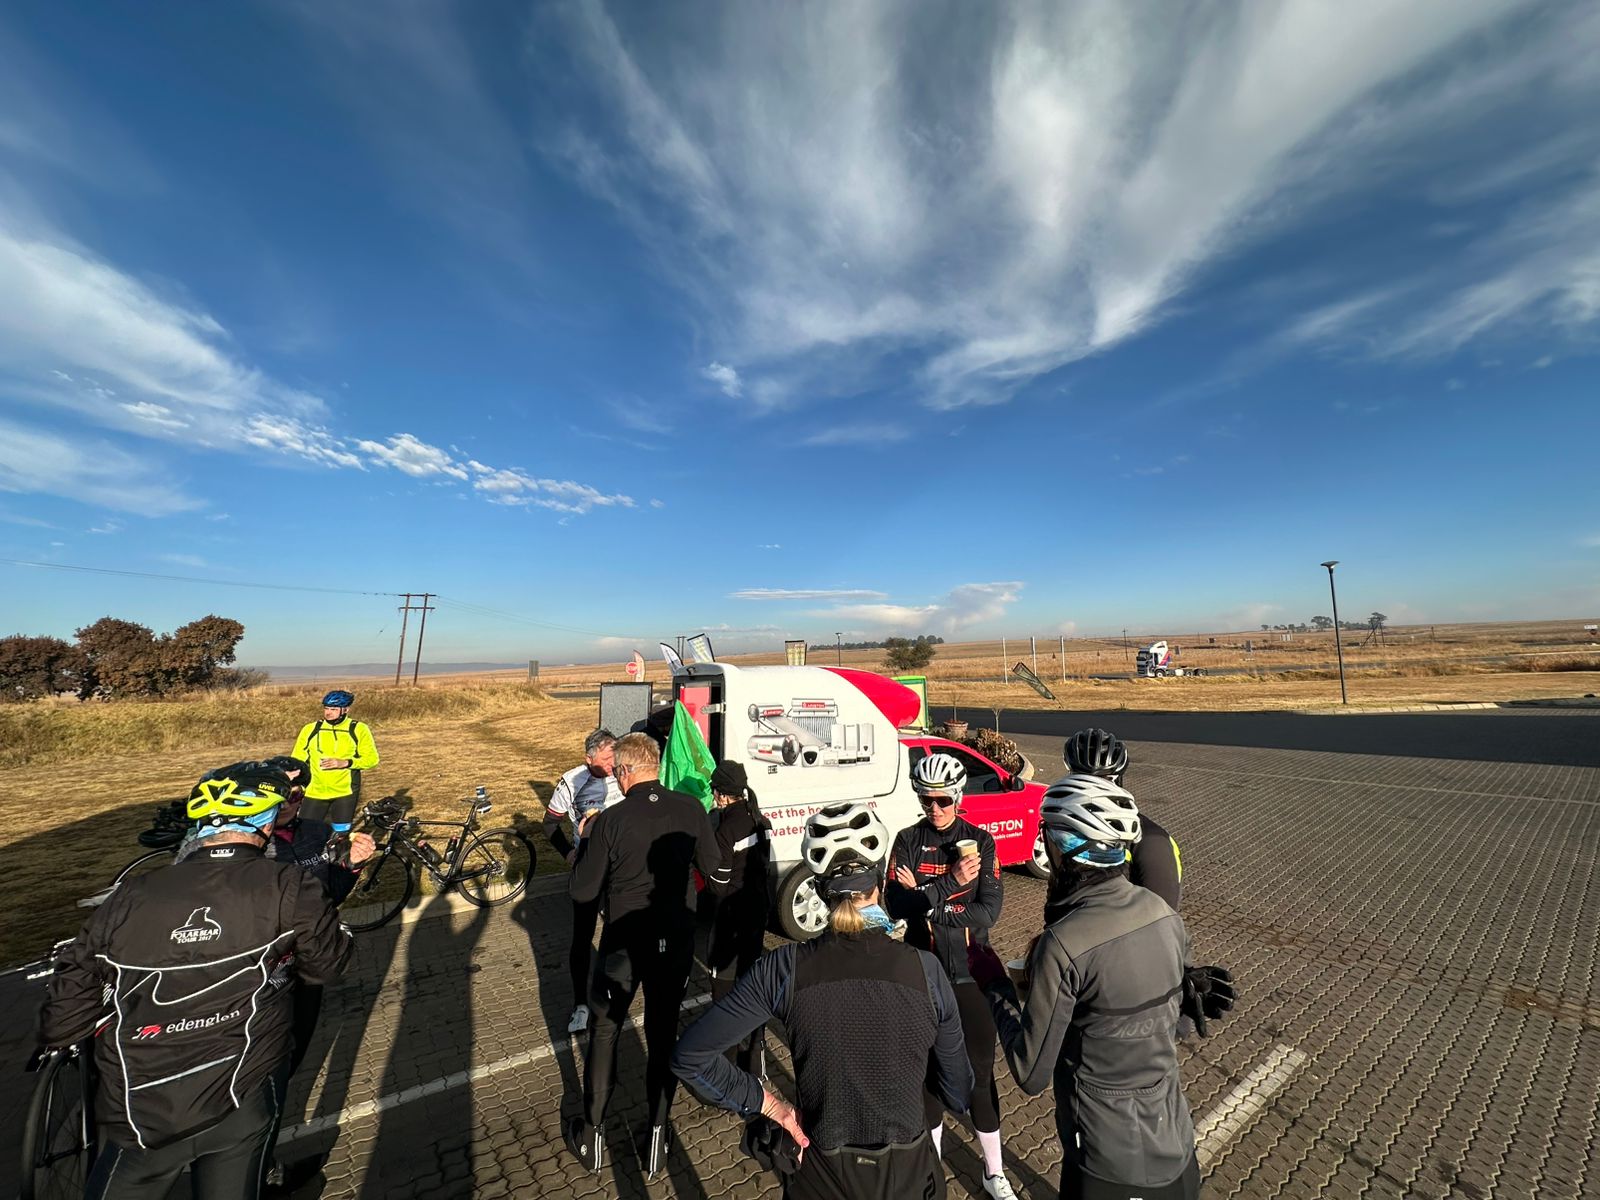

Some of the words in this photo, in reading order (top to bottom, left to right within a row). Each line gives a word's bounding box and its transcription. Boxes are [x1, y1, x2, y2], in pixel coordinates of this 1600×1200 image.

[785, 808, 805, 818] the
[978, 819, 1023, 833] RISTON
[166, 1010, 240, 1034] edenglen
